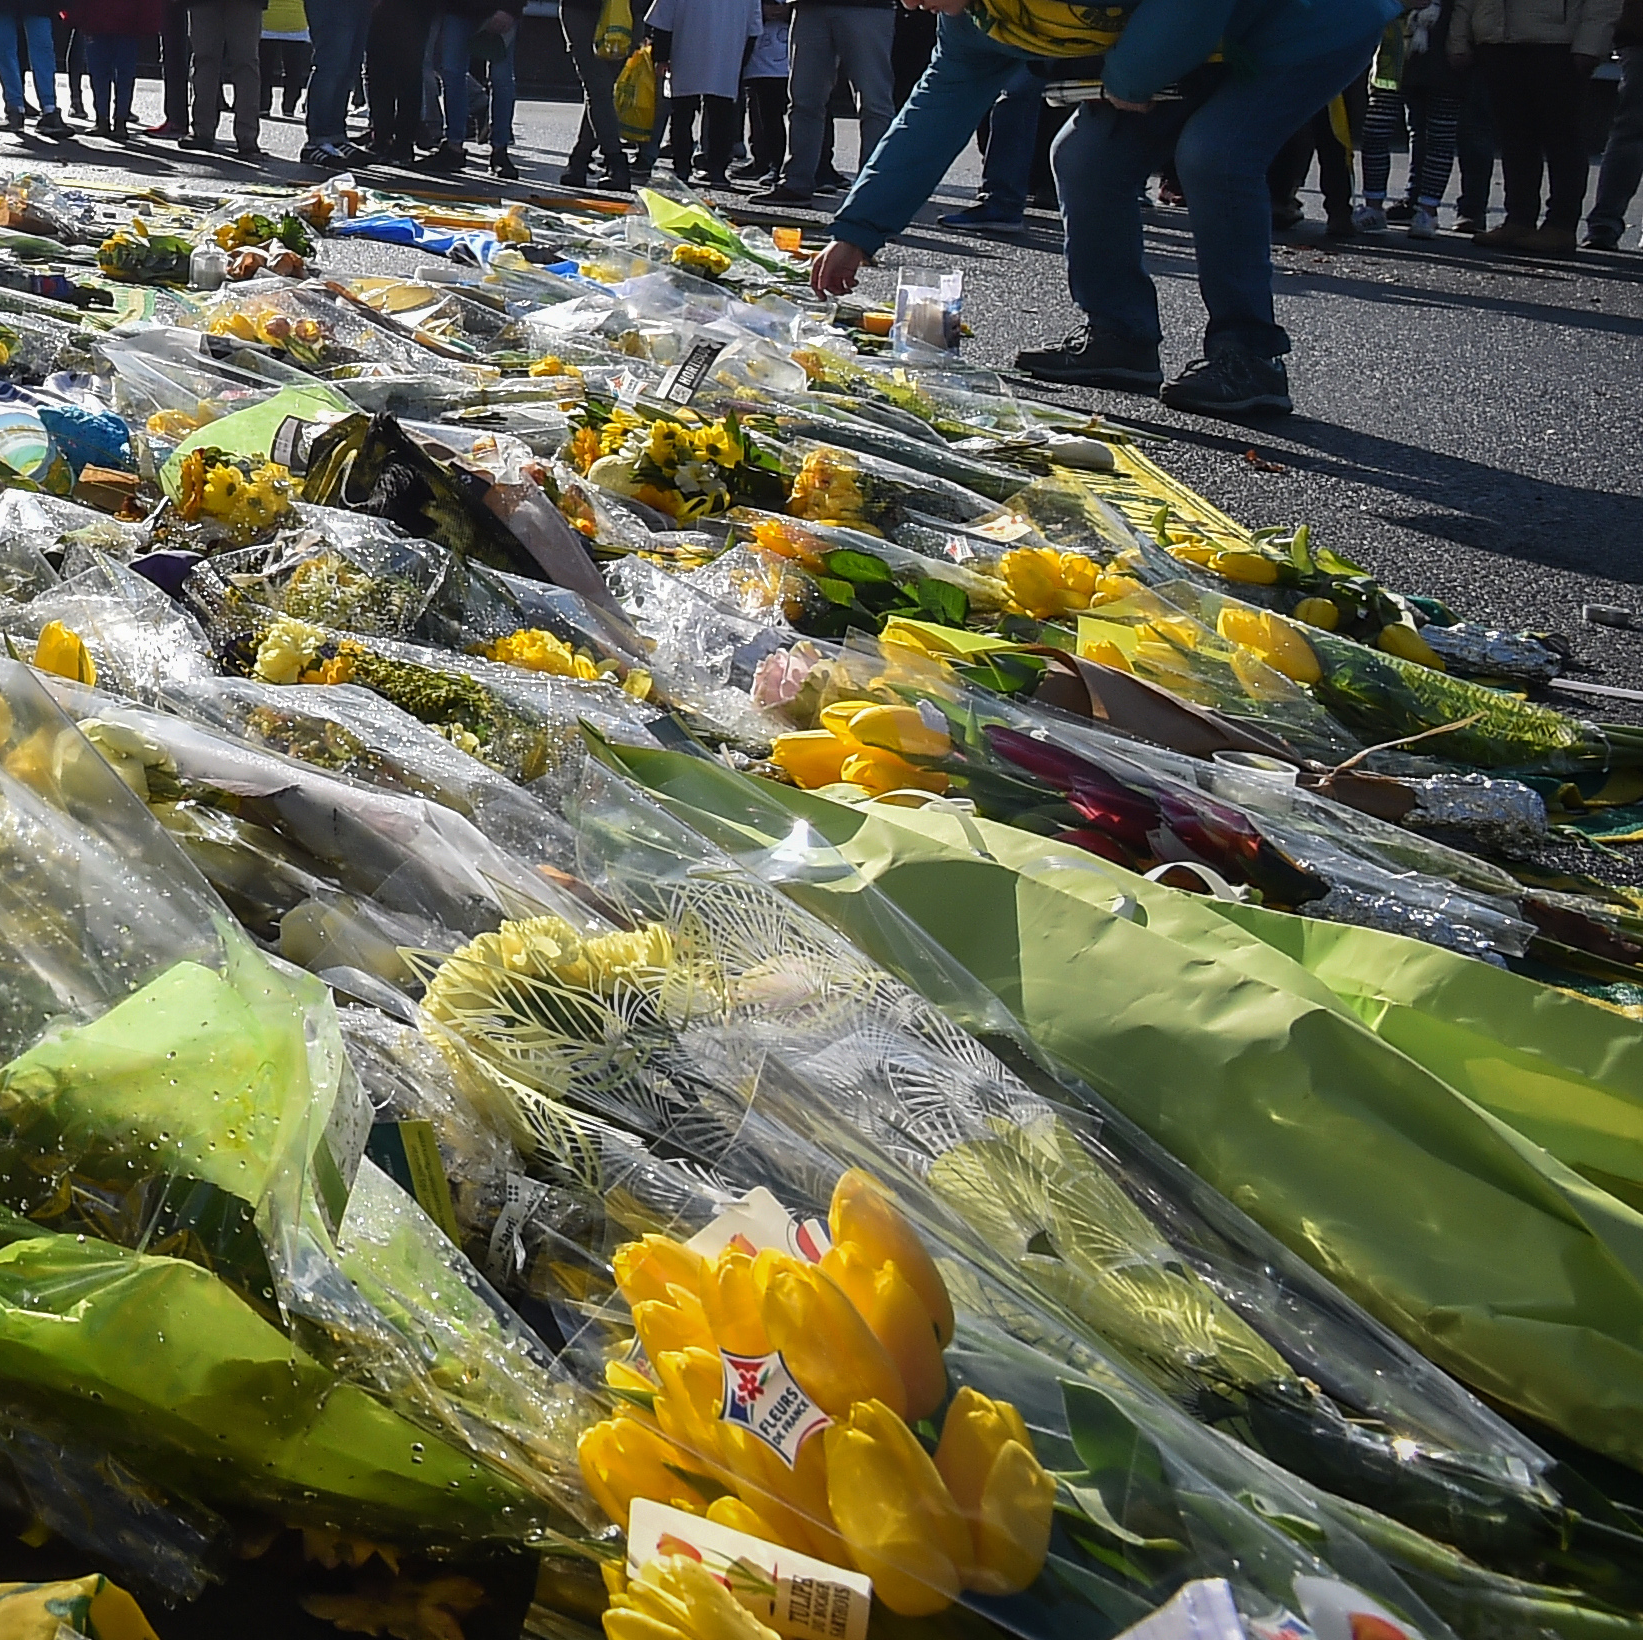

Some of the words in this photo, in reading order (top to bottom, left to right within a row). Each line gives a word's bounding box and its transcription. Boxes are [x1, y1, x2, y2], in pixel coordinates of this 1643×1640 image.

[759, 1386, 799, 1436] FLEURS
[772, 1433, 786, 1446] DE
[781, 1398, 810, 1434] FRANCE
